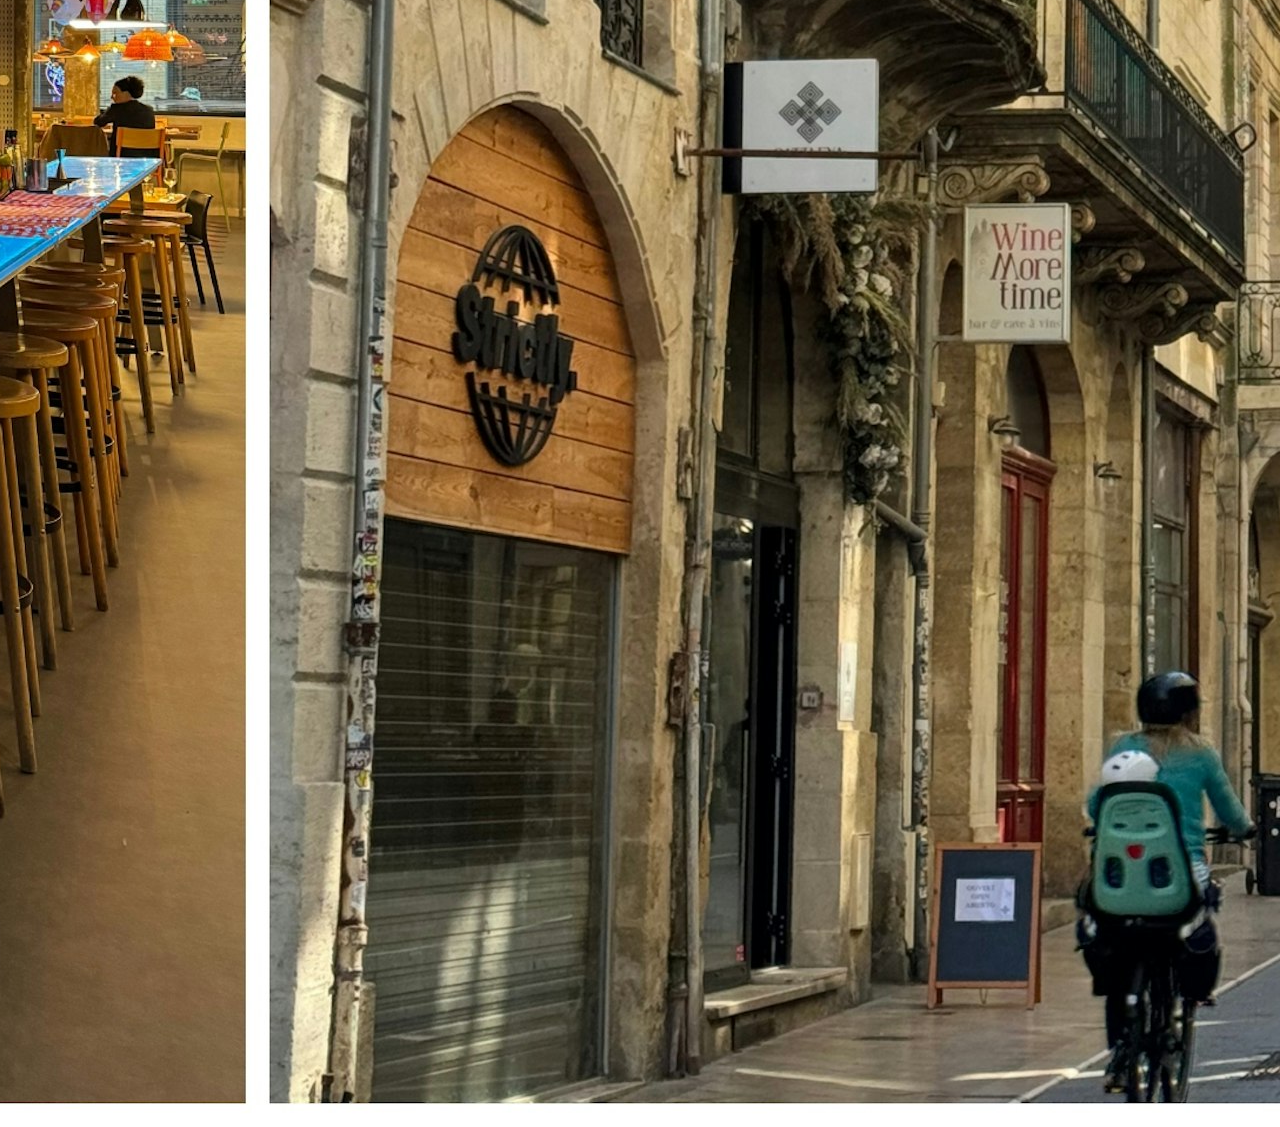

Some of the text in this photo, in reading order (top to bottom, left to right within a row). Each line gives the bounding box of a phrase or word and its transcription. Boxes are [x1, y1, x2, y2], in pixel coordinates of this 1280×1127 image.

[991, 221, 1063, 252] Wine
[990, 252, 1063, 282] More
[1000, 282, 1063, 311] time
[969, 317, 989, 330] bar
[1038, 318, 1063, 329] vins
